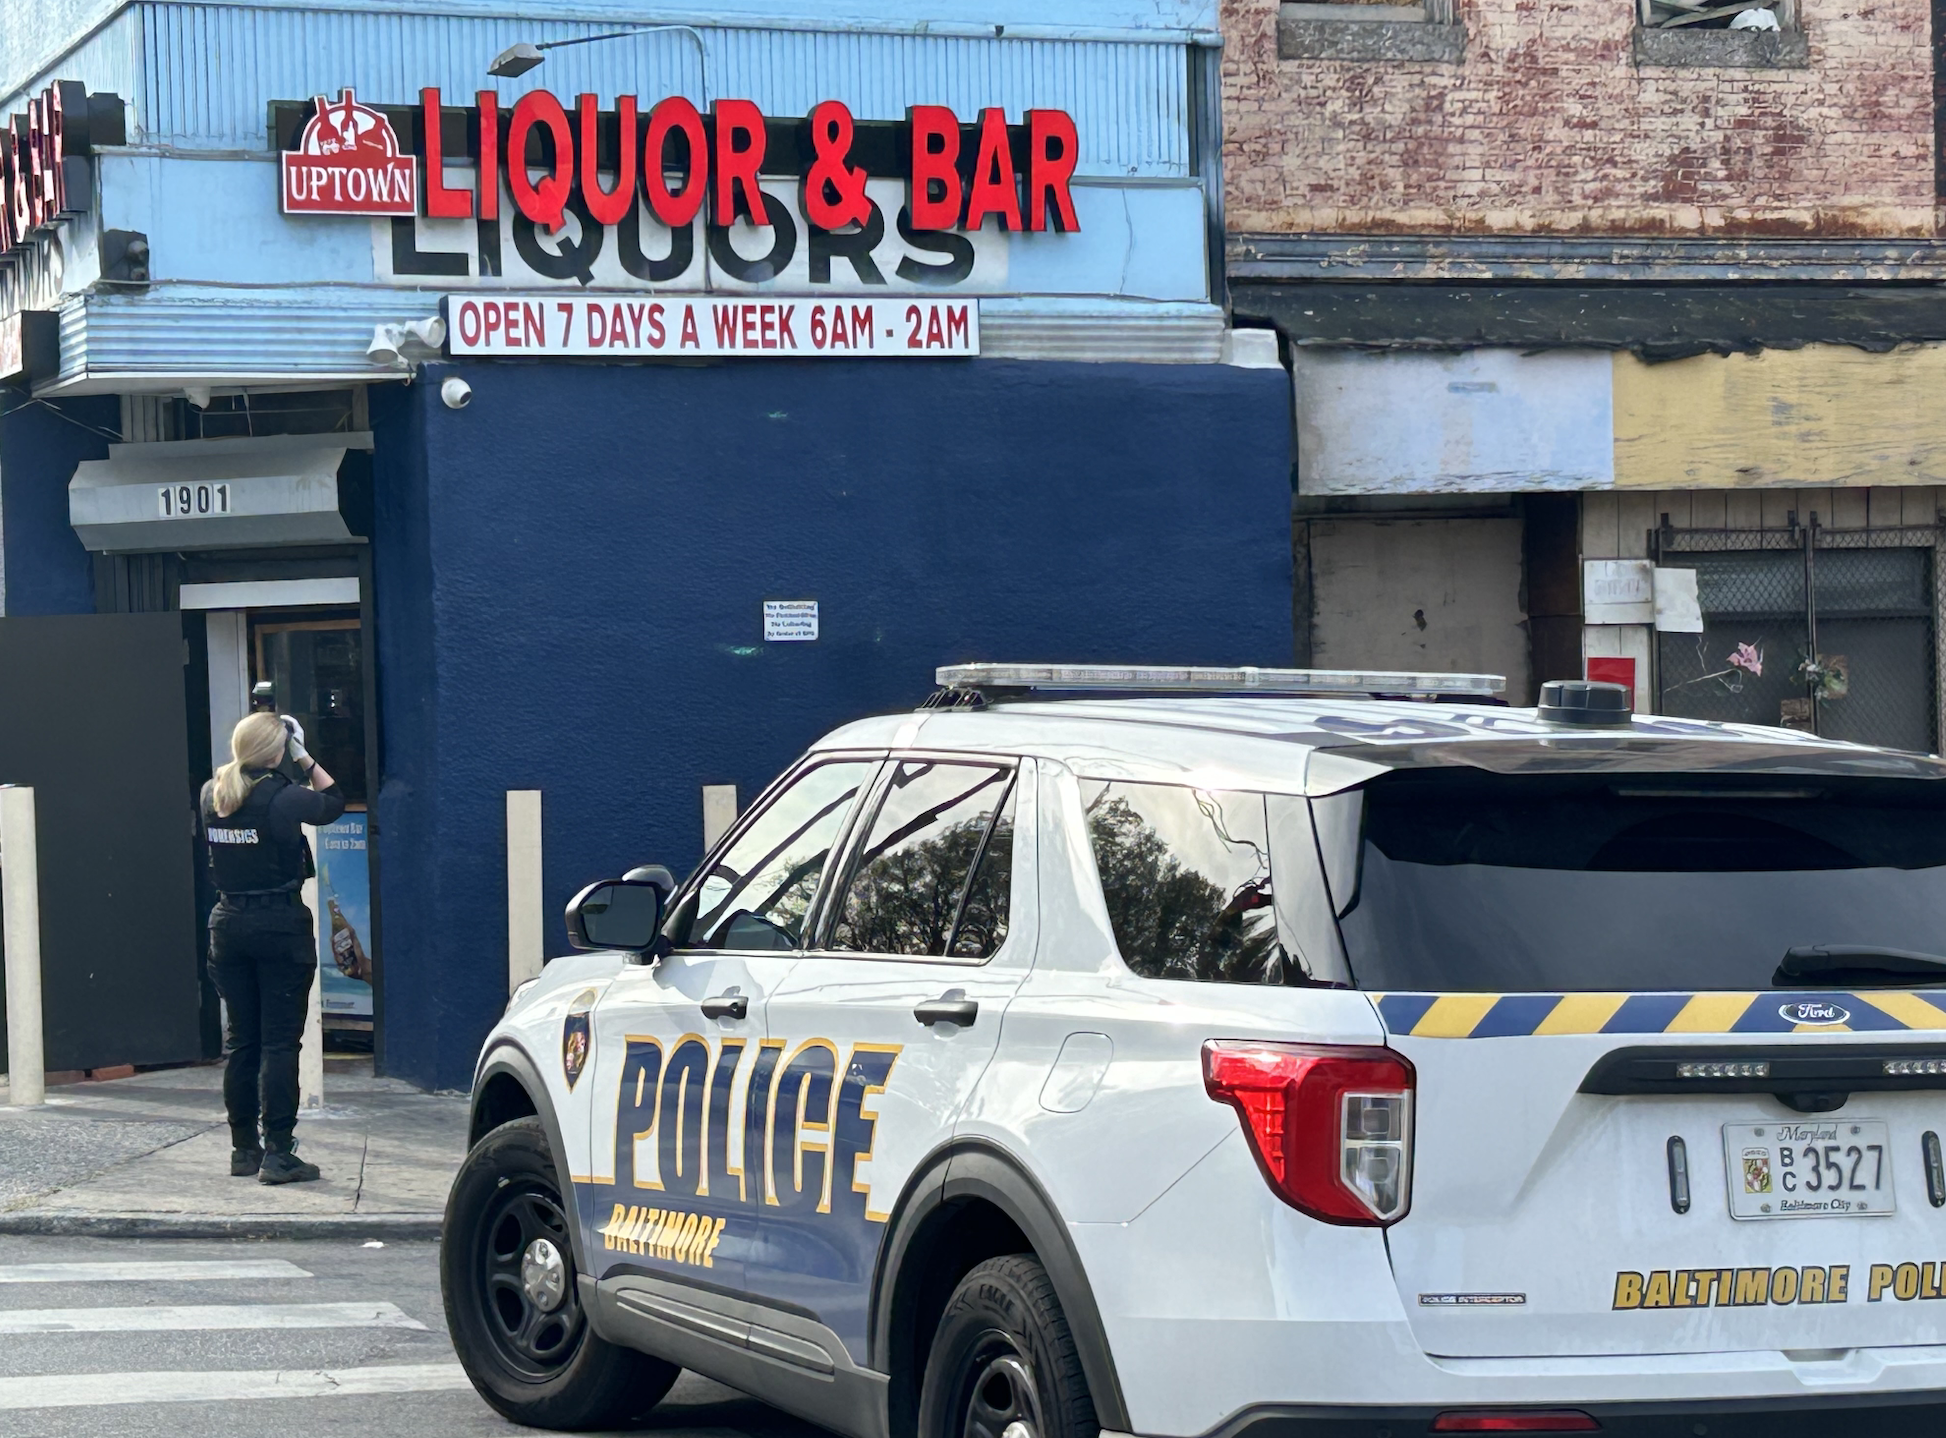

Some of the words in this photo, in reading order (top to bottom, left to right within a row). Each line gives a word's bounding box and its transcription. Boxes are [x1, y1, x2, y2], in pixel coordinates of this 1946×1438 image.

[290, 161, 410, 202] UPTOWN
[421, 87, 771, 235] LIQUOR
[805, 100, 873, 230] &
[908, 105, 1081, 232] BAR
[459, 301, 546, 348] OPEN
[557, 302, 574, 348] 7
[587, 303, 666, 349] DAYS
[680, 304, 700, 349] A
[712, 304, 798, 349] WEEK
[811, 305, 874, 349] 6AM
[905, 305, 969, 349] 2AM
[161, 484, 227, 515] 1901
[1798, 1003, 1835, 1018] Ford
[612, 1032, 904, 1223] POLICE
[1777, 1124, 1838, 1145] Maryland
[1802, 1145, 1883, 1192] 3527
[602, 1203, 726, 1268] BALTIMORE
[1612, 1264, 1850, 1311] BALTIMORE
